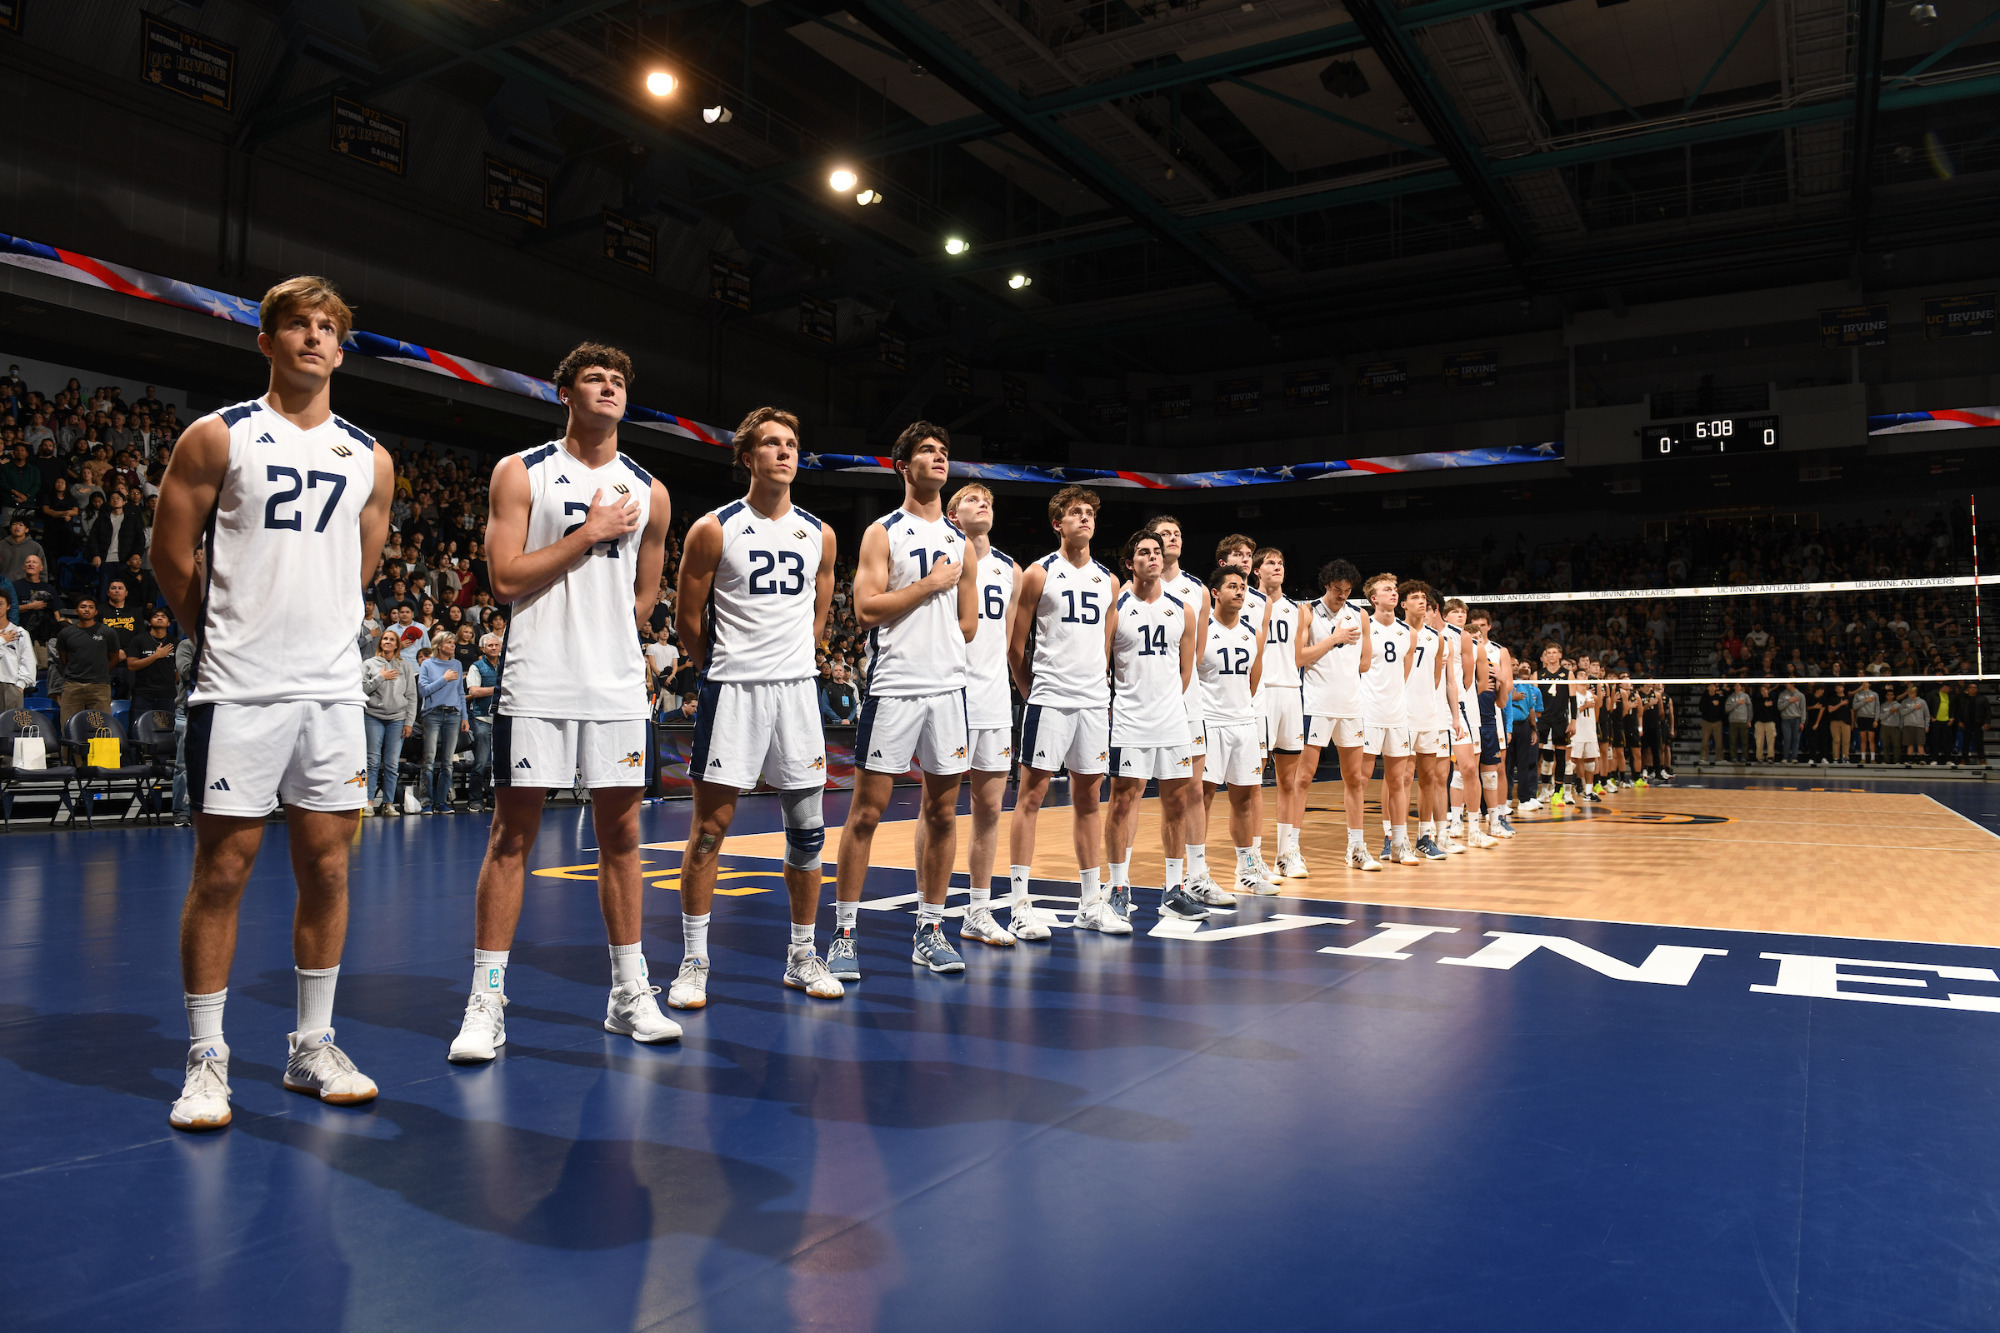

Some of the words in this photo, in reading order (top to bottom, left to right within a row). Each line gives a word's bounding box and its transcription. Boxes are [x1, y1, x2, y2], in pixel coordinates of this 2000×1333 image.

[180, 32, 202, 49] 1971
[150, 32, 183, 51] NATIONAL
[190, 47, 228, 68] CHAMPIONS
[149, 51, 172, 69] UC
[176, 55, 227, 81] IRVINE
[360, 106, 382, 121] 1972
[337, 107, 364, 124] NATIONAL
[369, 119, 400, 137] CHAMPIONS
[336, 124, 356, 141] UC
[357, 126, 400, 149] IRVINE
[370, 147, 399, 163] SAILING
[1927, 314, 1945, 325] UC
[1948, 309, 1994, 322] IRVINE
[1822, 325, 1839, 336] UC
[1843, 320, 1887, 333] IRVINE
[1445, 368, 1458, 376] UC
[1462, 364, 1497, 375] IRVINE
[1357, 377, 1370, 386] UC
[1372, 373, 1407, 384] IRVINE
[1231, 391, 1260, 401] IRVINE
[1286, 387, 1298, 396] UC
[1300, 383, 1331, 394] IRVINE
[1696, 419, 1733, 438] 6:08
[1748, 419, 1774, 428] GUEST
[1647, 428, 1668, 437] HOME
[1763, 428, 1775, 445] 0
[1660, 437, 1671, 453] 0
[1720, 440, 1724, 452] 1
[264, 464, 347, 533] 27
[749, 550, 805, 596] 23
[1760, 584, 1810, 592] ANTEATERS
[1869, 580, 1899, 588] IRVINE
[1901, 577, 1955, 586] ANTEATERS
[1482, 594, 1505, 602] IRVINE
[1507, 592, 1551, 600] ANTEATERS
[1628, 588, 1676, 596] ANTEATERS
[1061, 591, 1100, 625] 15
[123, 623, 134, 631] 49
[1267, 619, 1288, 644] 10
[1138, 625, 1168, 656] 14
[1384, 641, 1397, 662] 8
[1415, 647, 1424, 668] 7
[1217, 648, 1250, 675] 12
[1548, 684, 1557, 696] 4
